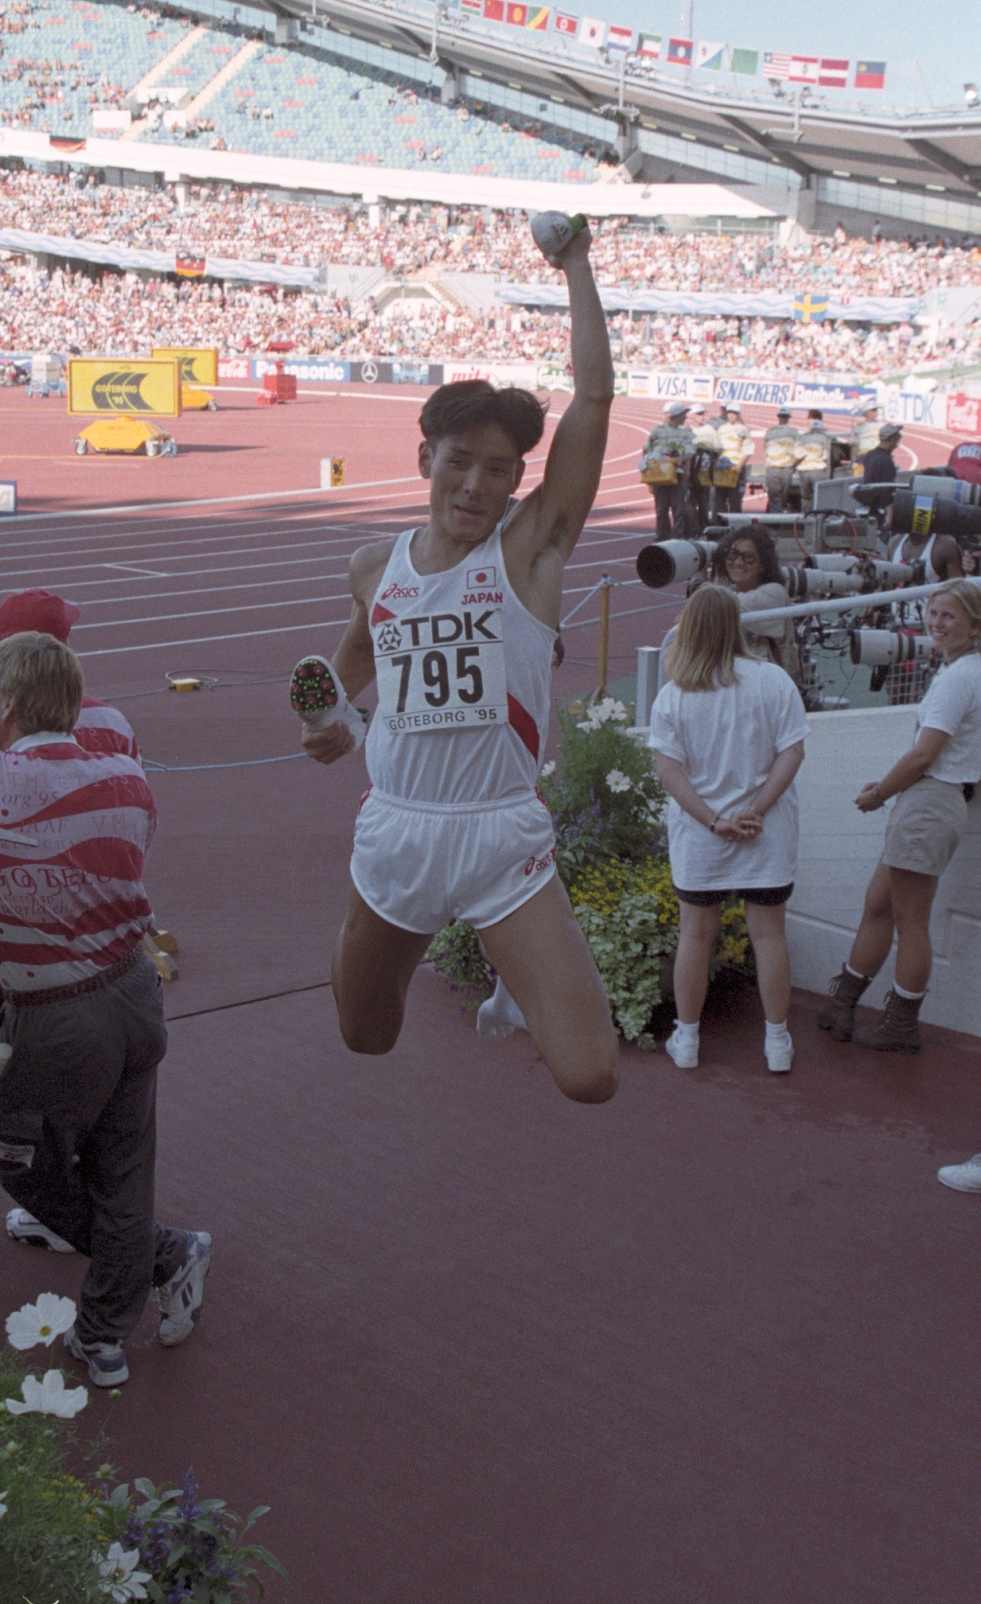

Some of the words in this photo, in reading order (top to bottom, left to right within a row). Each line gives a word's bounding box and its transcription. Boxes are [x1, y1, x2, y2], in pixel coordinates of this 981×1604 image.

[256, 361, 344, 380] Paasonic
[657, 376, 687, 397] VISA
[717, 380, 791, 404] SNICKERS
[900, 393, 936, 425] TDK
[461, 592, 503, 606] JAPAN
[400, 610, 498, 647] TDK
[391, 646, 484, 713] 795
[389, 711, 466, 731] GÖTEBORG
